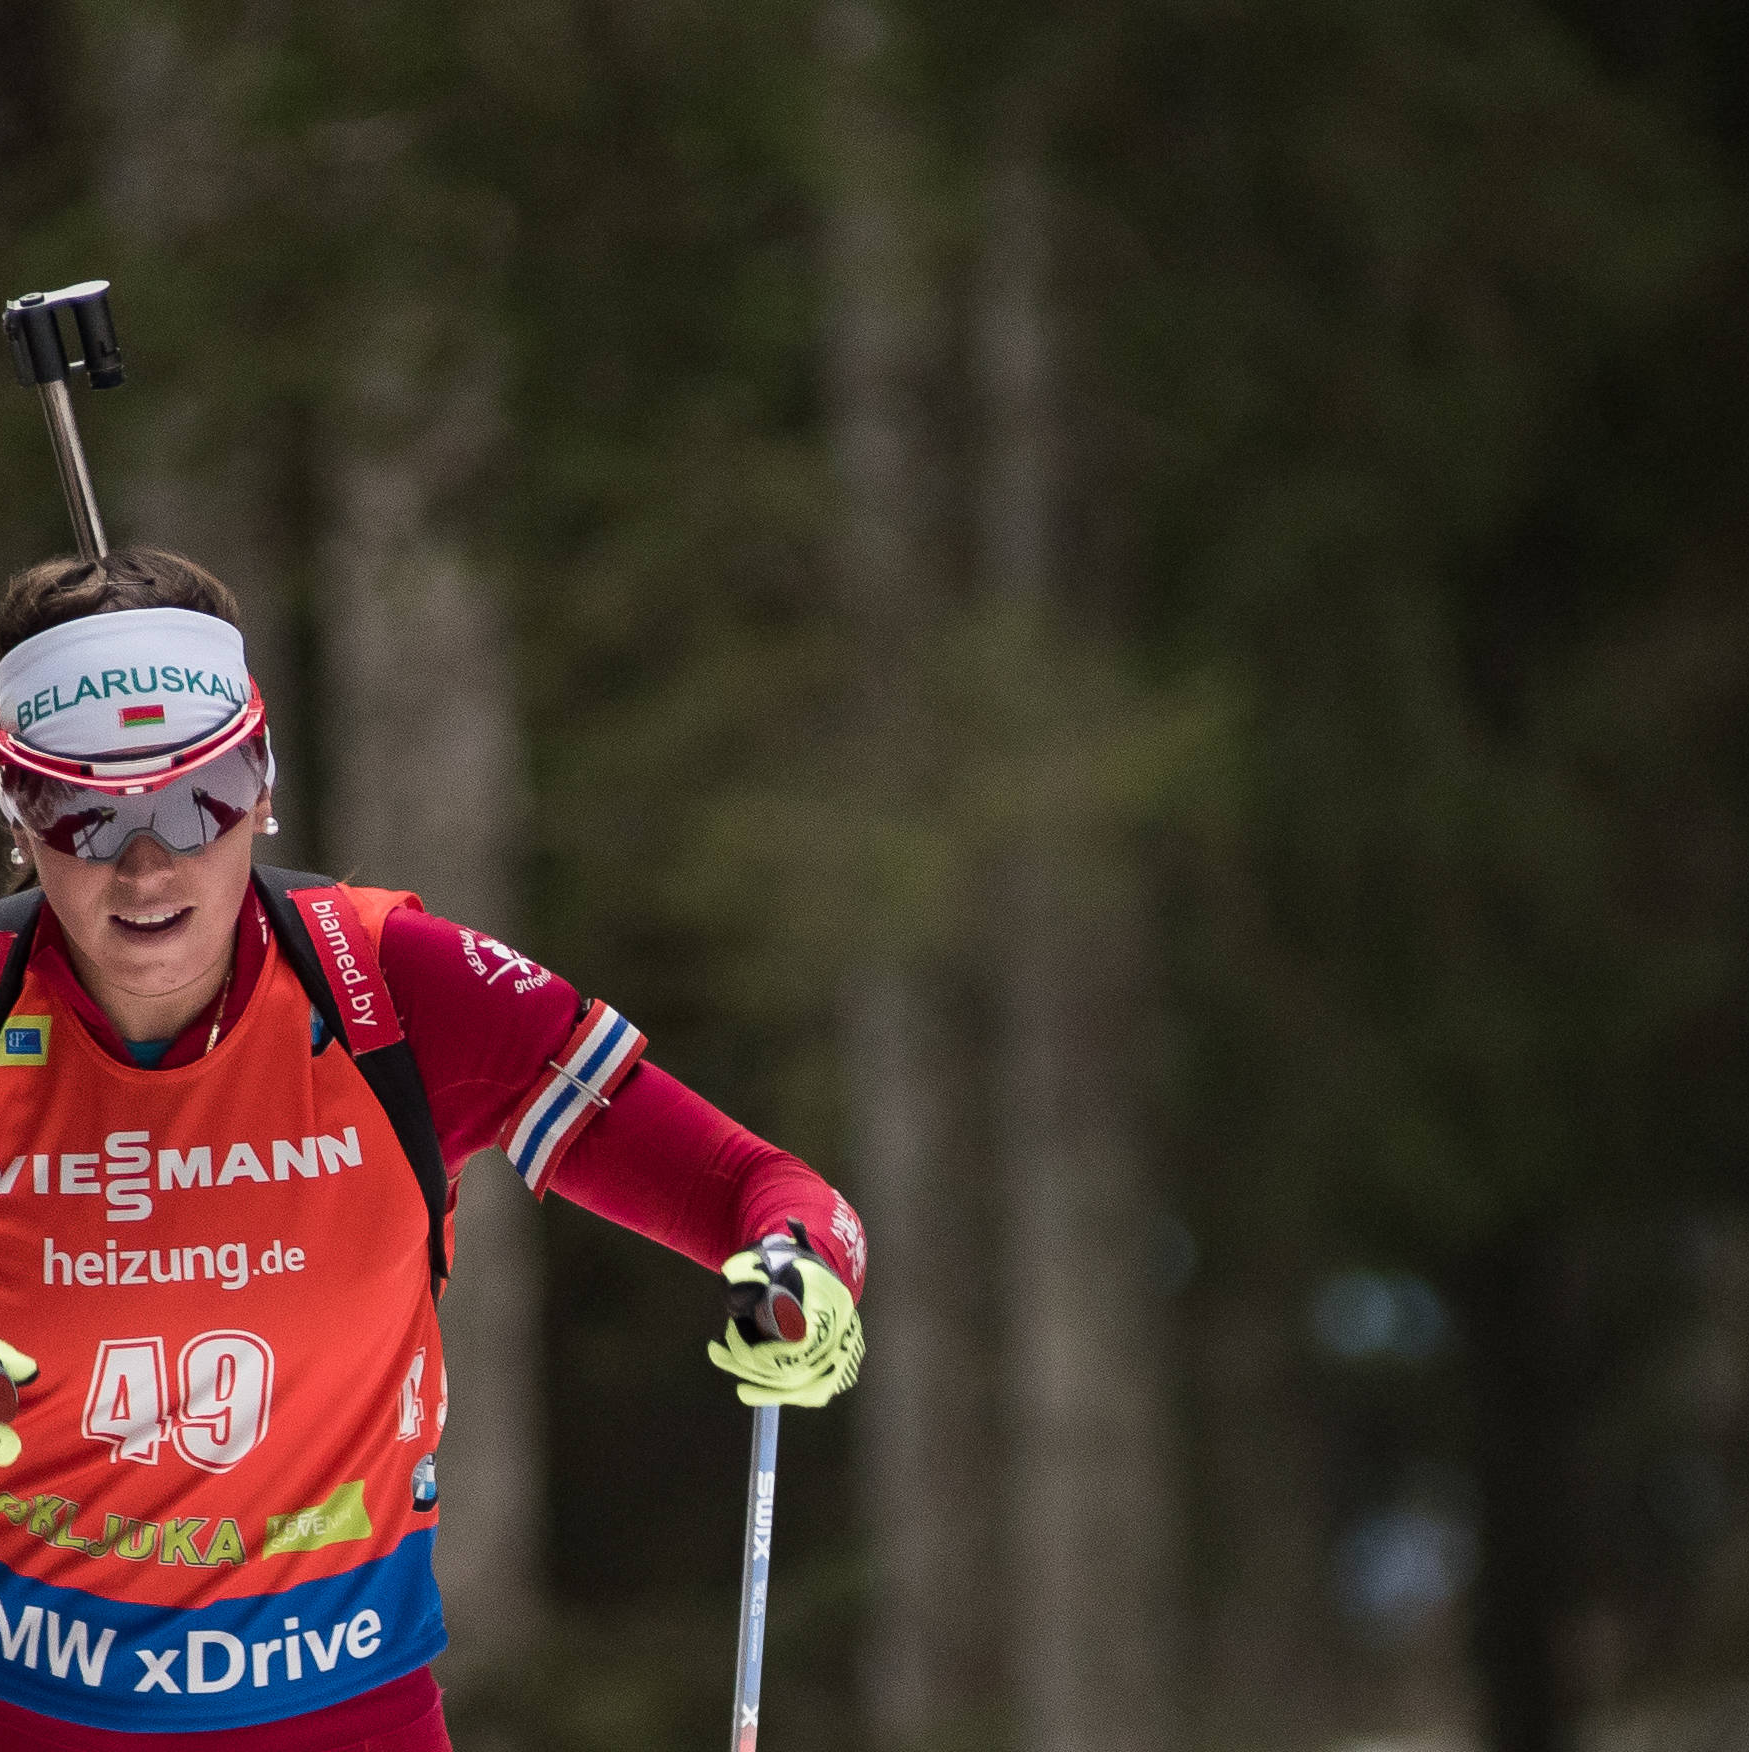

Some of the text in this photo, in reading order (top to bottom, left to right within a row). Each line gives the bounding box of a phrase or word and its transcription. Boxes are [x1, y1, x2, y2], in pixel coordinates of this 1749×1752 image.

[17, 665, 247, 732] BELARUSKALI
[310, 899, 378, 1028] biamed.by
[43, 1238, 306, 1289] heizung.de
[82, 1329, 275, 1474] 49
[133, 1608, 382, 1694] xDrive
